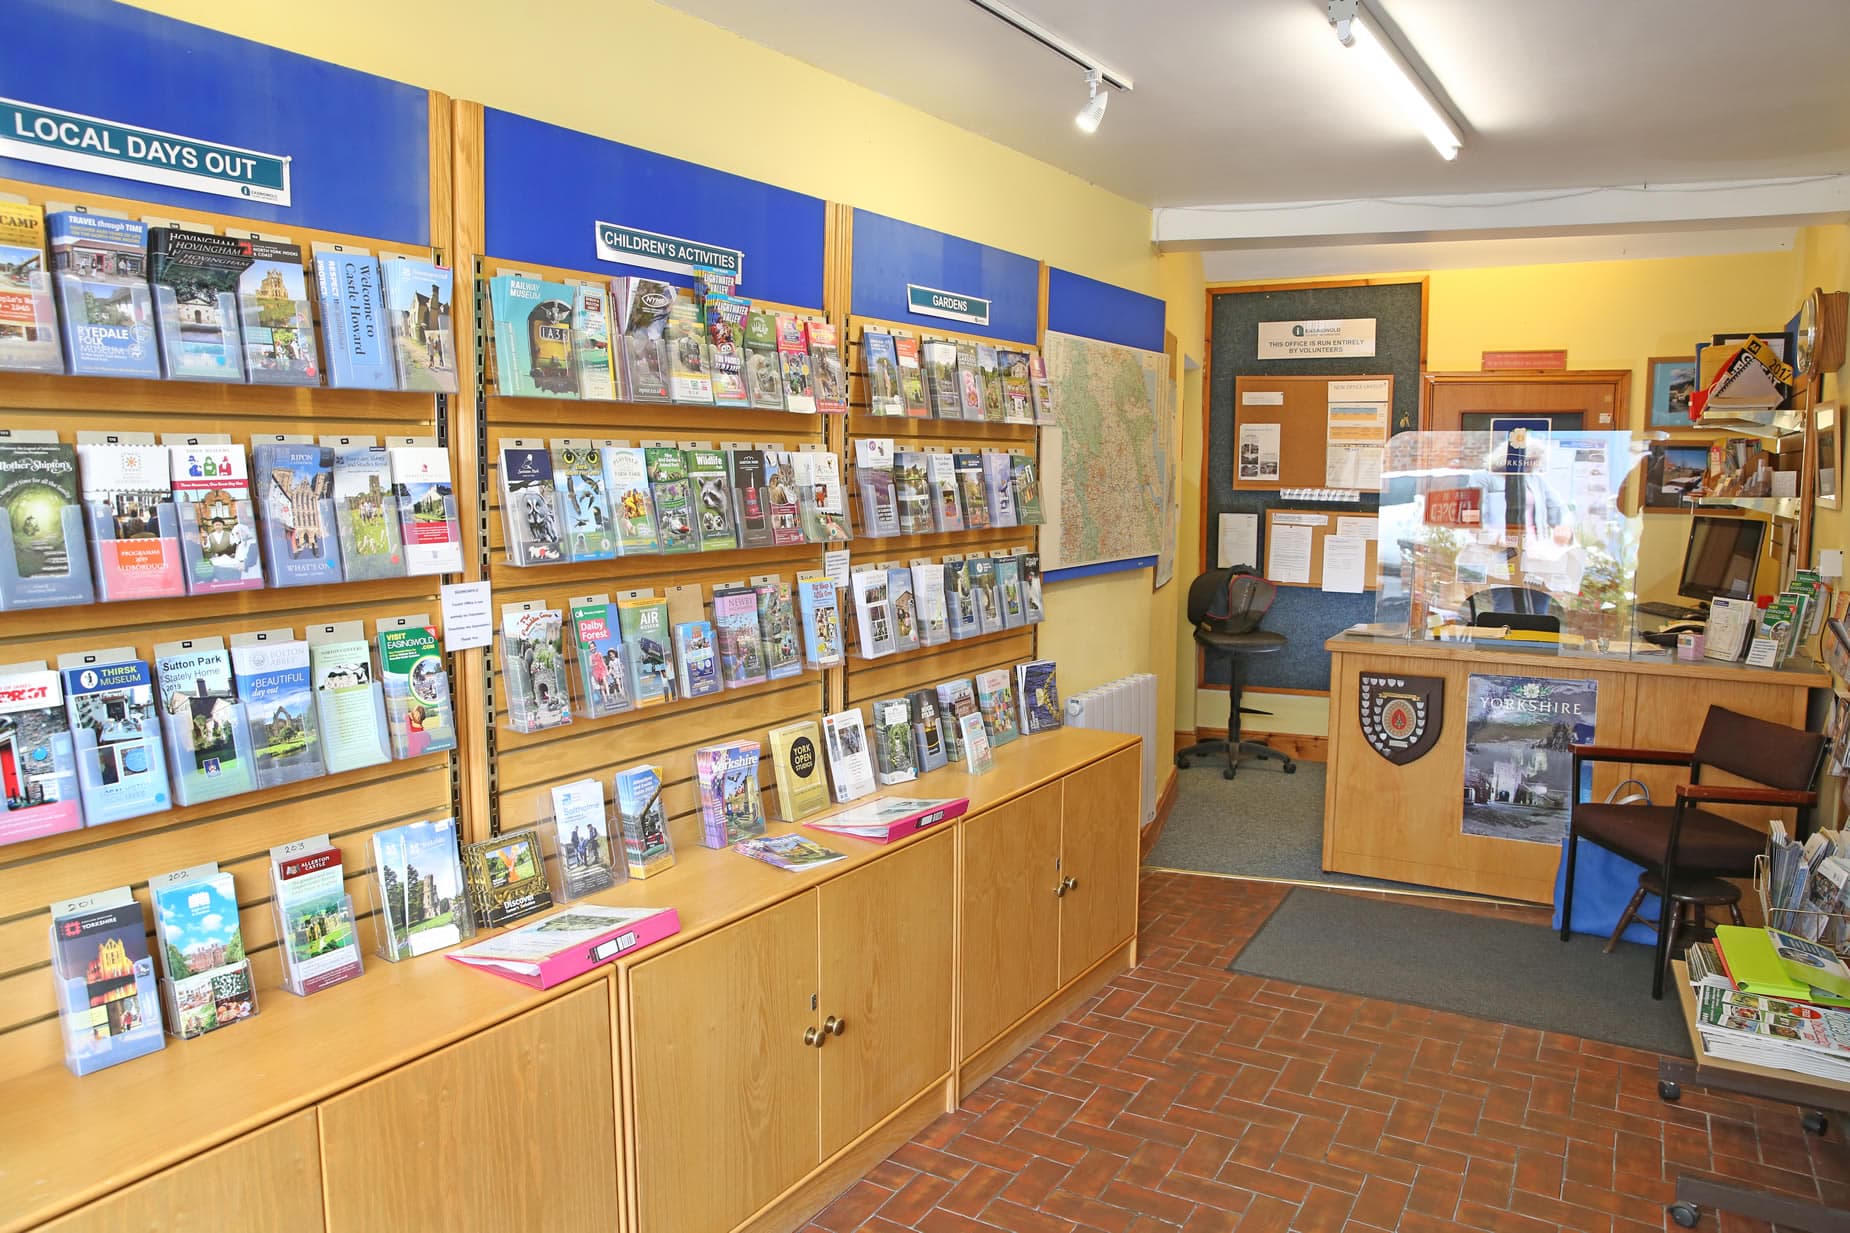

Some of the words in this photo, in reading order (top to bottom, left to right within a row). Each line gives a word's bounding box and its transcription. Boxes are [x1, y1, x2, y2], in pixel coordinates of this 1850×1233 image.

[14, 112, 120, 155] LOCAL
[127, 135, 199, 169] DAYS
[205, 152, 257, 179] OUT
[68, 215, 97, 227] TRAVEL
[124, 223, 143, 233] TIME
[175, 241, 241, 256] HOVINGHAM
[604, 231, 676, 257] CHILDREN'S
[678, 246, 735, 269] ACTIVITIES
[345, 262, 359, 301] Castle
[510, 280, 541, 292] RAILWAY
[510, 289, 541, 300] MUSEUM
[359, 265, 372, 321] Welcome
[366, 324, 374, 338] to
[932, 295, 968, 312] GARDENS
[77, 325, 129, 340] RYEDALE
[350, 305, 367, 355] Howard
[696, 454, 722, 465] Wildlife
[640, 611, 659, 625] AIR
[580, 620, 604, 631] Dalby
[386, 632, 406, 641] VISIT
[582, 630, 608, 640] Forest
[387, 636, 435, 649] EASINGWOLD
[101, 665, 137, 676] THIRSK
[163, 659, 196, 672] Sutton
[197, 656, 222, 666] Park
[100, 674, 141, 686] MUSEUM
[164, 672, 192, 684] Stately
[194, 668, 220, 678] Home
[255, 672, 305, 688] BEAUTIFUL
[251, 686, 266, 697] day
[266, 686, 279, 695] out
[1479, 696, 1582, 715] YORKSHIRE
[793, 744, 811, 756] YORK
[711, 753, 759, 773] Yorkshire
[794, 753, 812, 764] OPEN
[795, 762, 813, 771] STUDIOS
[285, 842, 305, 853] 203
[301, 856, 330, 867] ALLERTON
[304, 862, 326, 870] CASTLE
[504, 895, 534, 909] Discover
[82, 917, 117, 930] YORKSHIRE
